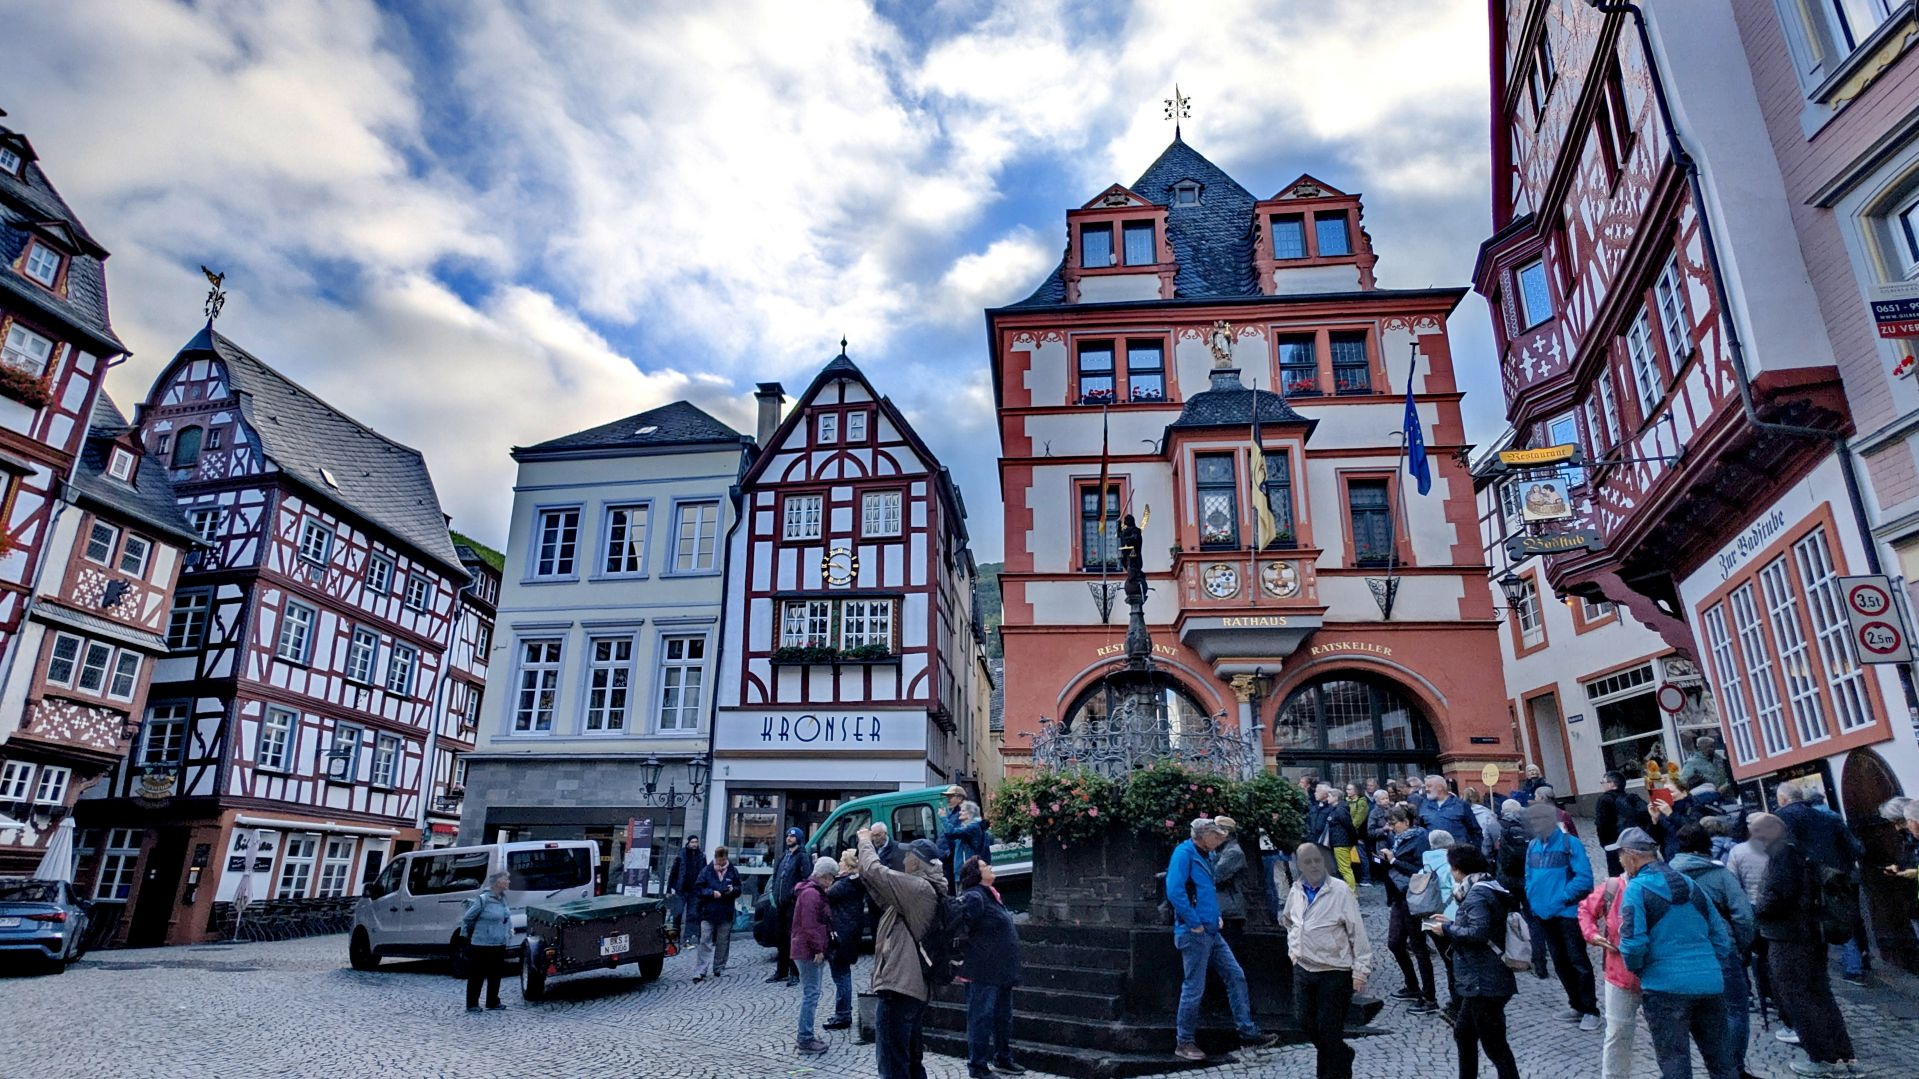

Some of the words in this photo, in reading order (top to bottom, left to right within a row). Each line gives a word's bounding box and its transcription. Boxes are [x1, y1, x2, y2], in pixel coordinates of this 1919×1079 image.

[1876, 303, 1900, 313] 0651
[1881, 325, 1896, 334] ZU
[1507, 448, 1566, 461] Restaurant
[1719, 550, 1737, 581] Zur
[1222, 616, 1287, 627] RATHAUS
[1096, 643, 1178, 657] RESTANT
[1311, 641, 1392, 656] RATSKELLER
[760, 714, 881, 742] KRONSER
